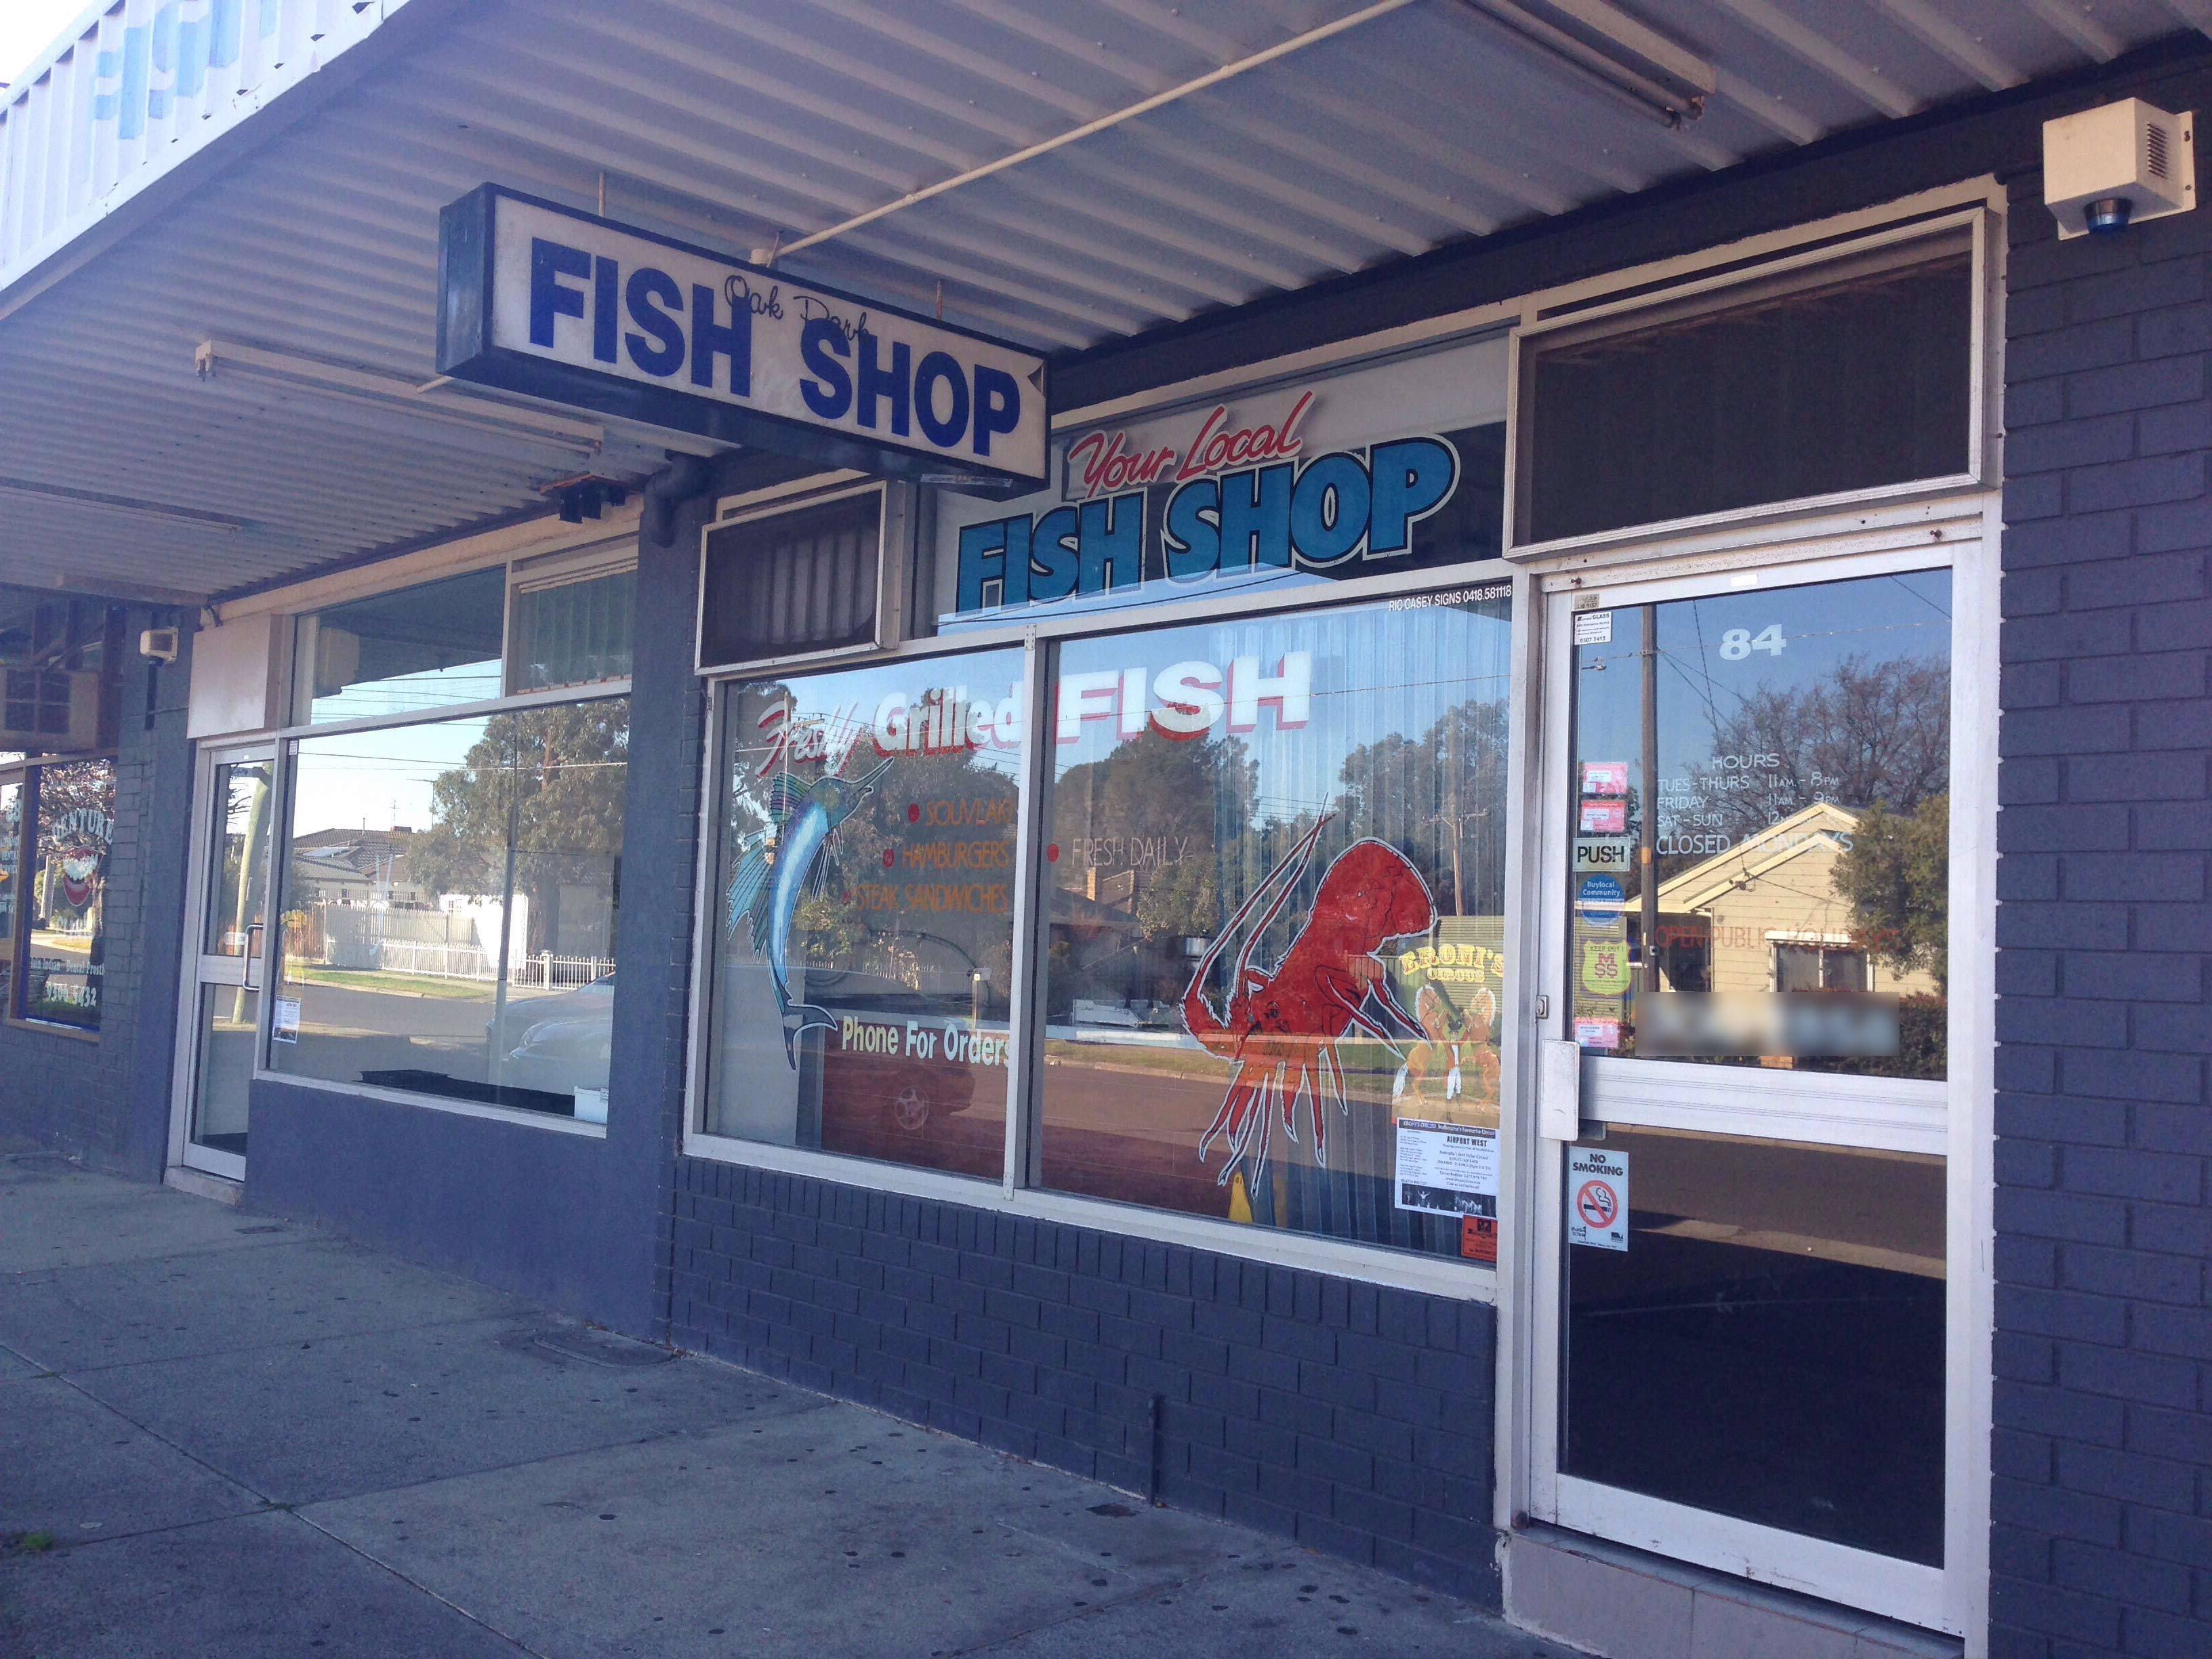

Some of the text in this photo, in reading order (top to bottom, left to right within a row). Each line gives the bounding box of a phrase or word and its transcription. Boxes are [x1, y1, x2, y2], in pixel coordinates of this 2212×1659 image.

[725, 275, 784, 320] Oak
[530, 237, 1021, 457] FISH SHOP
[1070, 391, 1313, 497] Your Local
[956, 436, 1460, 616] FISH SHOP
[1389, 585, 1512, 612] RIC CASEY SIGNS 0418.581118
[1719, 623, 1787, 661] 84
[1053, 651, 1312, 744] FISH
[874, 681, 1021, 758] Grilled
[1713, 753, 1780, 770] HOURS
[1658, 796, 1708, 810] FRIDAY
[902, 840, 1010, 868] HAMBURGERS
[1071, 836, 1189, 867] FRESH DAILY
[1578, 846, 1624, 863] PUSH
[1656, 834, 1731, 855] CLOSED
[857, 884, 1009, 914] STEAK SANDWICHES
[1656, 926, 1707, 949] OPEN
[1713, 926, 1774, 949] PUBLIC
[1427, 968, 1485, 982] CIRCUS
[842, 1015, 898, 1055] Phone
[906, 1020, 937, 1059] For
[1447, 1136, 1488, 1147] AIRPORT WEST
[1572, 1162, 1624, 1176] SMOKING
[1590, 1154, 1606, 1164] NO
